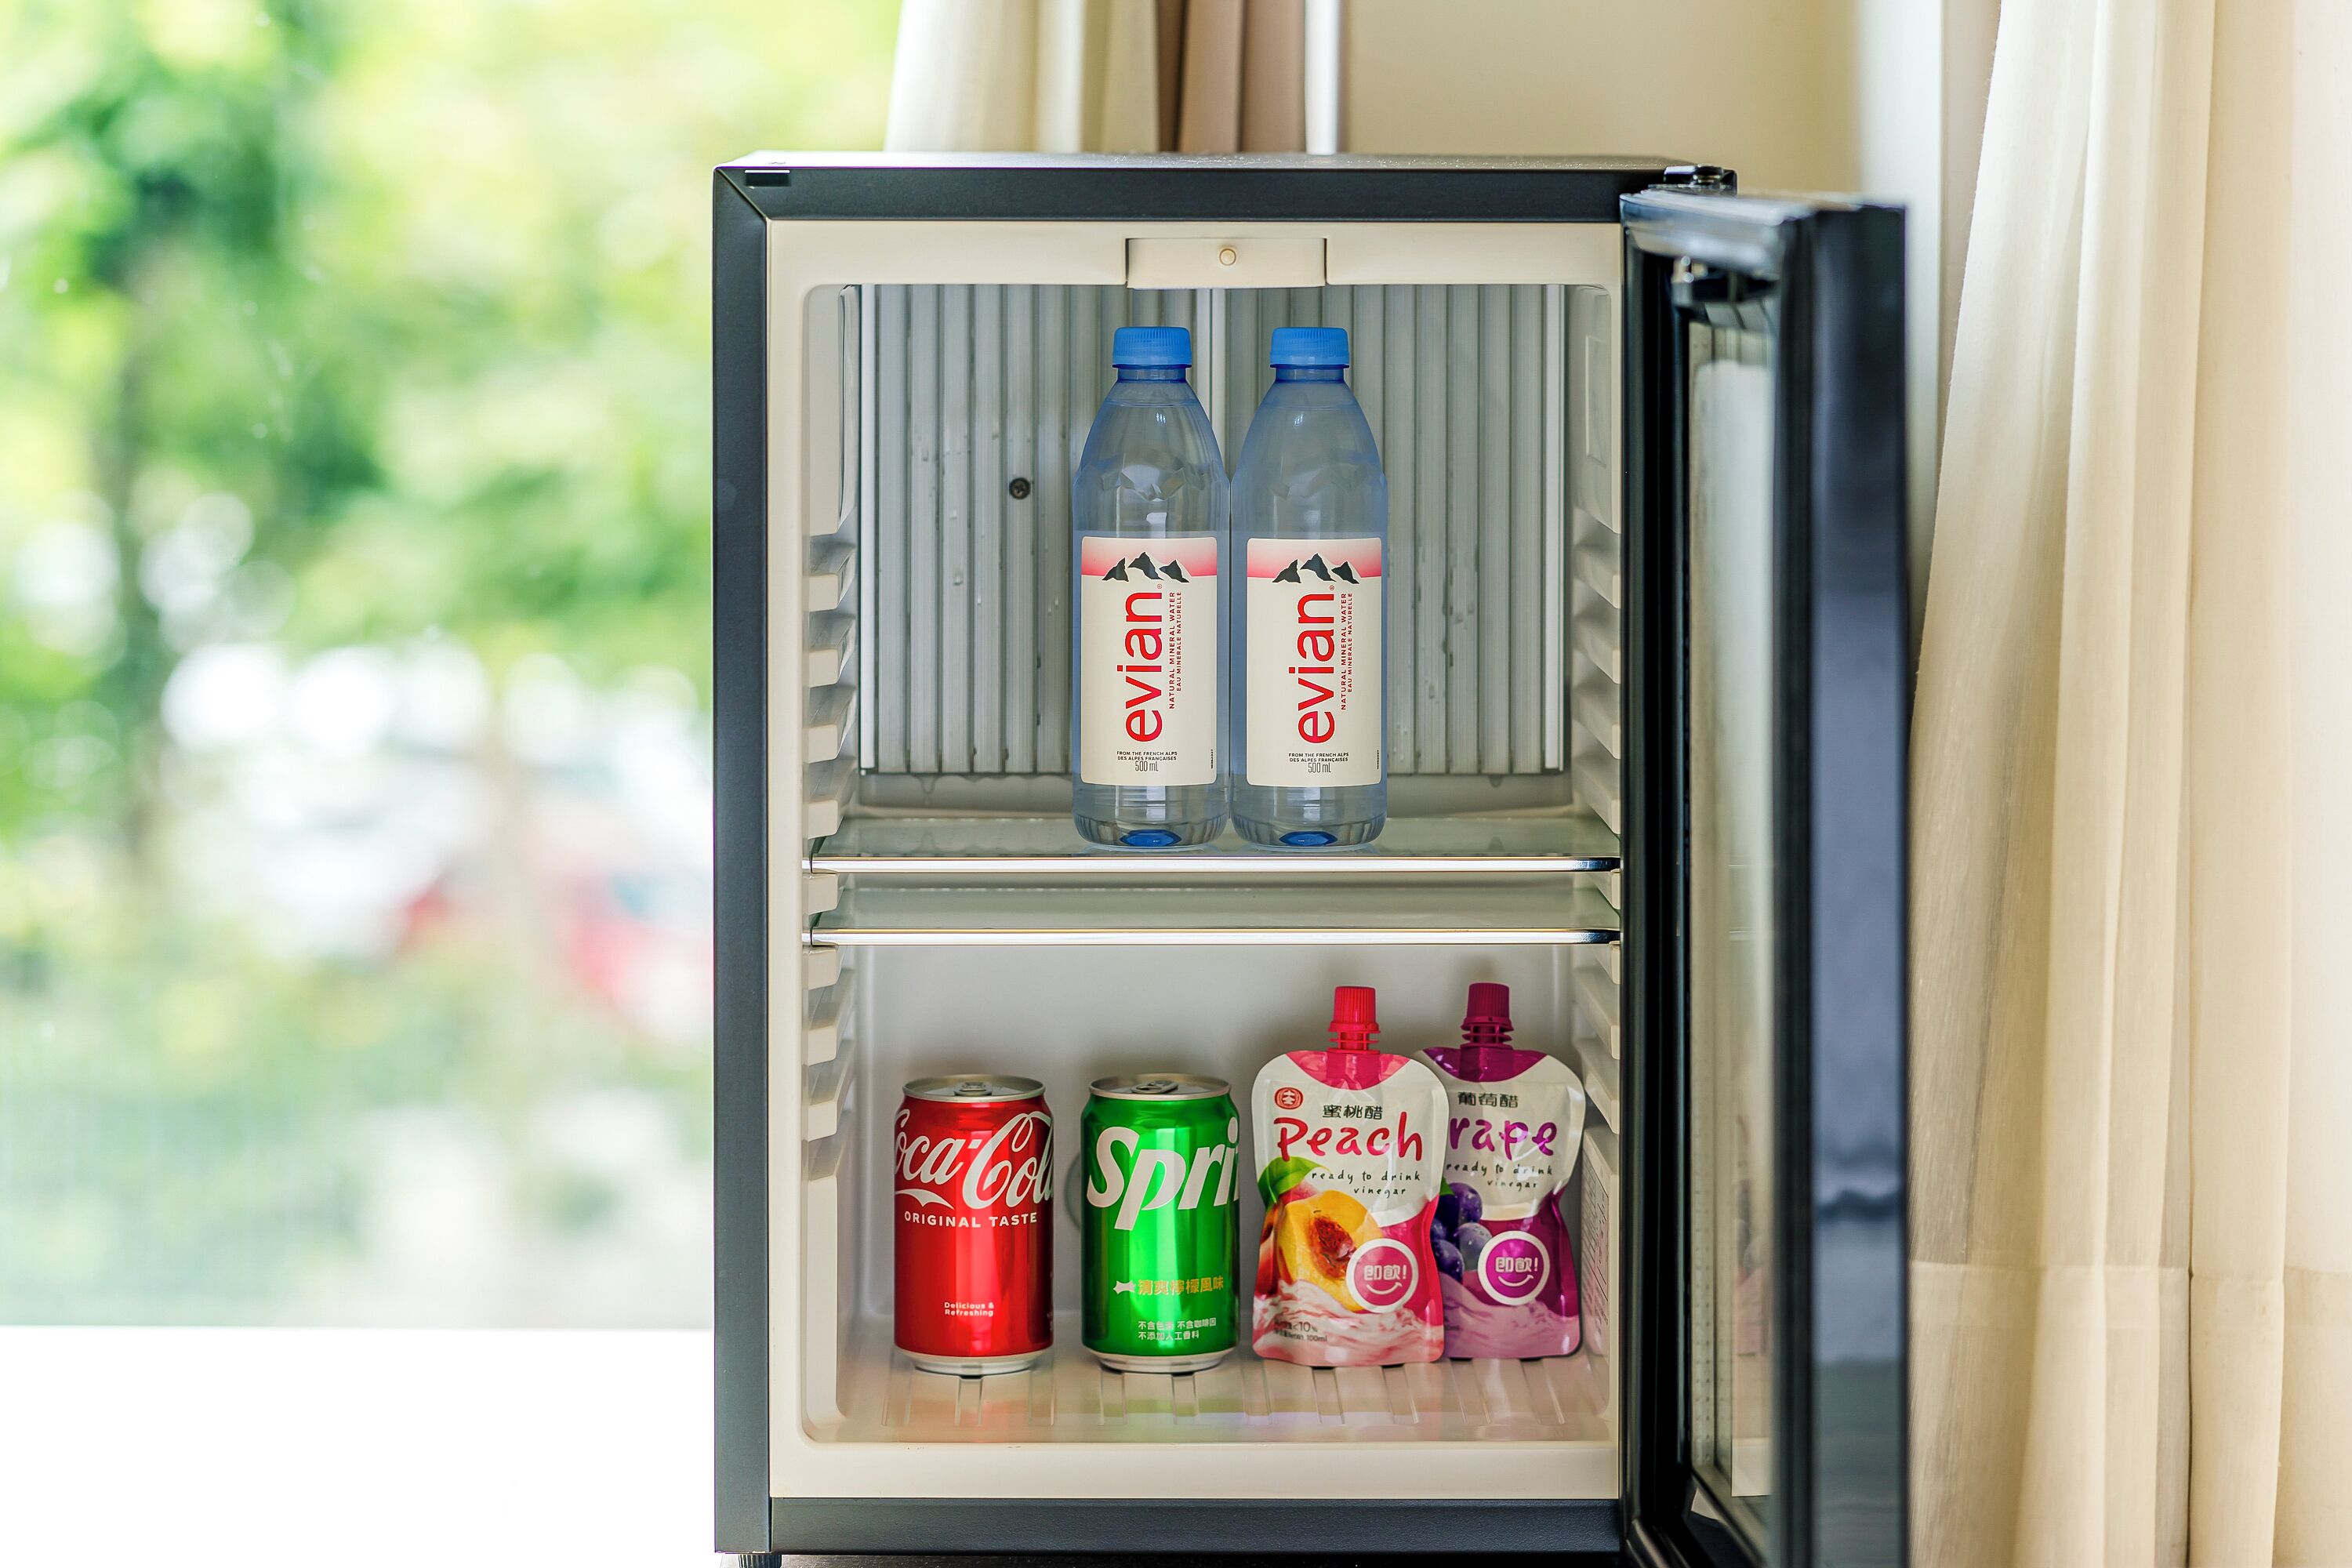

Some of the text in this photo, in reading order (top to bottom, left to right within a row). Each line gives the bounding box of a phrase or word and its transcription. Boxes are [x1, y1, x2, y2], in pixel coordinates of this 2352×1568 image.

[1116, 592, 1163, 742] evian
[1288, 593, 1335, 744] evian
[1134, 760, 1149, 771] 500
[1308, 762, 1321, 773] 500
[1457, 1091, 1519, 1109] 葡萄醋
[1322, 1104, 1383, 1120] 蜜桃醋
[1273, 1111, 1423, 1162] Peach
[1449, 1117, 1557, 1160] rape
[1087, 1116, 1240, 1231] Spri
[1312, 1170, 1421, 1184] ready to drink
[1446, 1161, 1552, 1176] ready to drink
[1353, 1186, 1406, 1198] vinegar
[1487, 1178, 1537, 1192] vinegar
[904, 1210, 1037, 1228] ORIGINAL TASTE
[1137, 1276, 1225, 1296] 清爽檸檬風味
[945, 1308, 994, 1317] Refreshing
